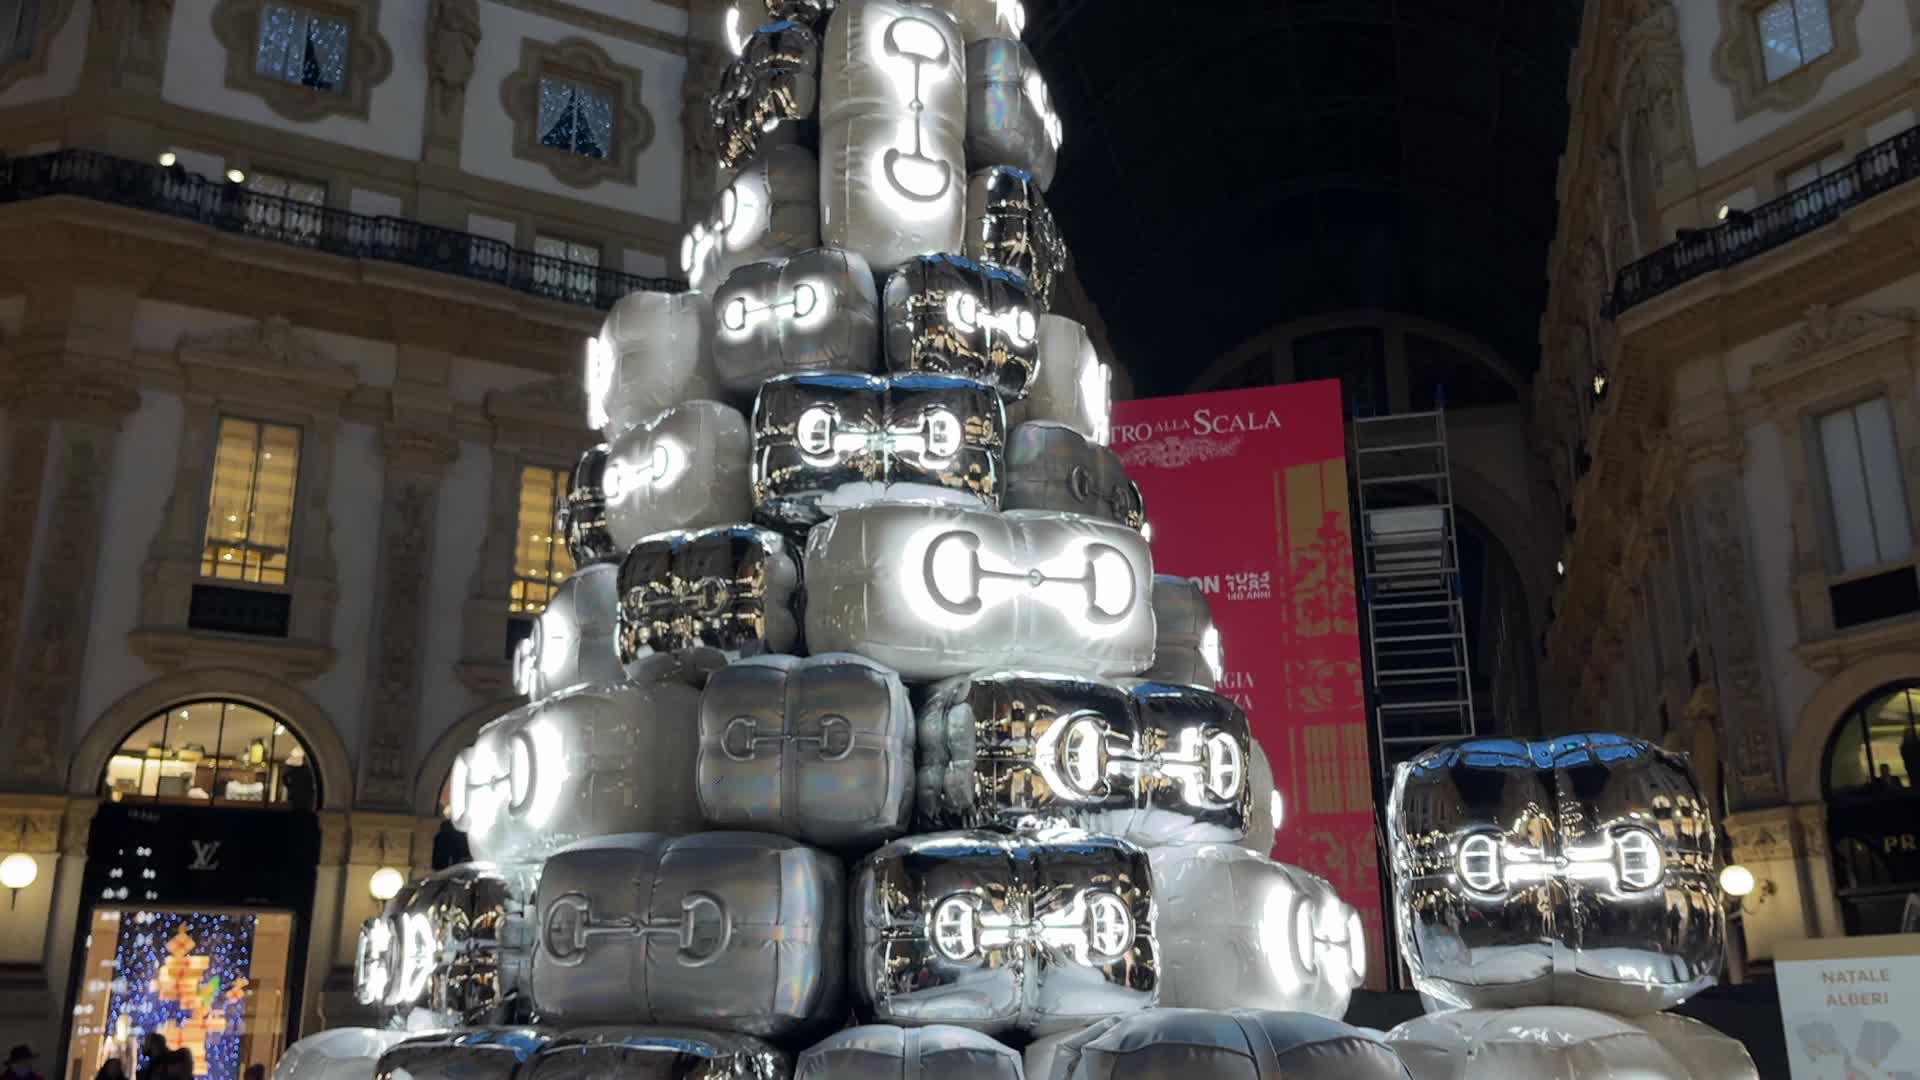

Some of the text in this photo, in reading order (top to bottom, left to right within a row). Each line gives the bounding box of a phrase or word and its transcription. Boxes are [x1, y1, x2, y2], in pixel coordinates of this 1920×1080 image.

[1155, 419, 1191, 432] ALLA
[1193, 409, 1281, 436] SCALA
[1822, 968, 1889, 984] NATALE
[1826, 991, 1889, 1008] ALBERI
